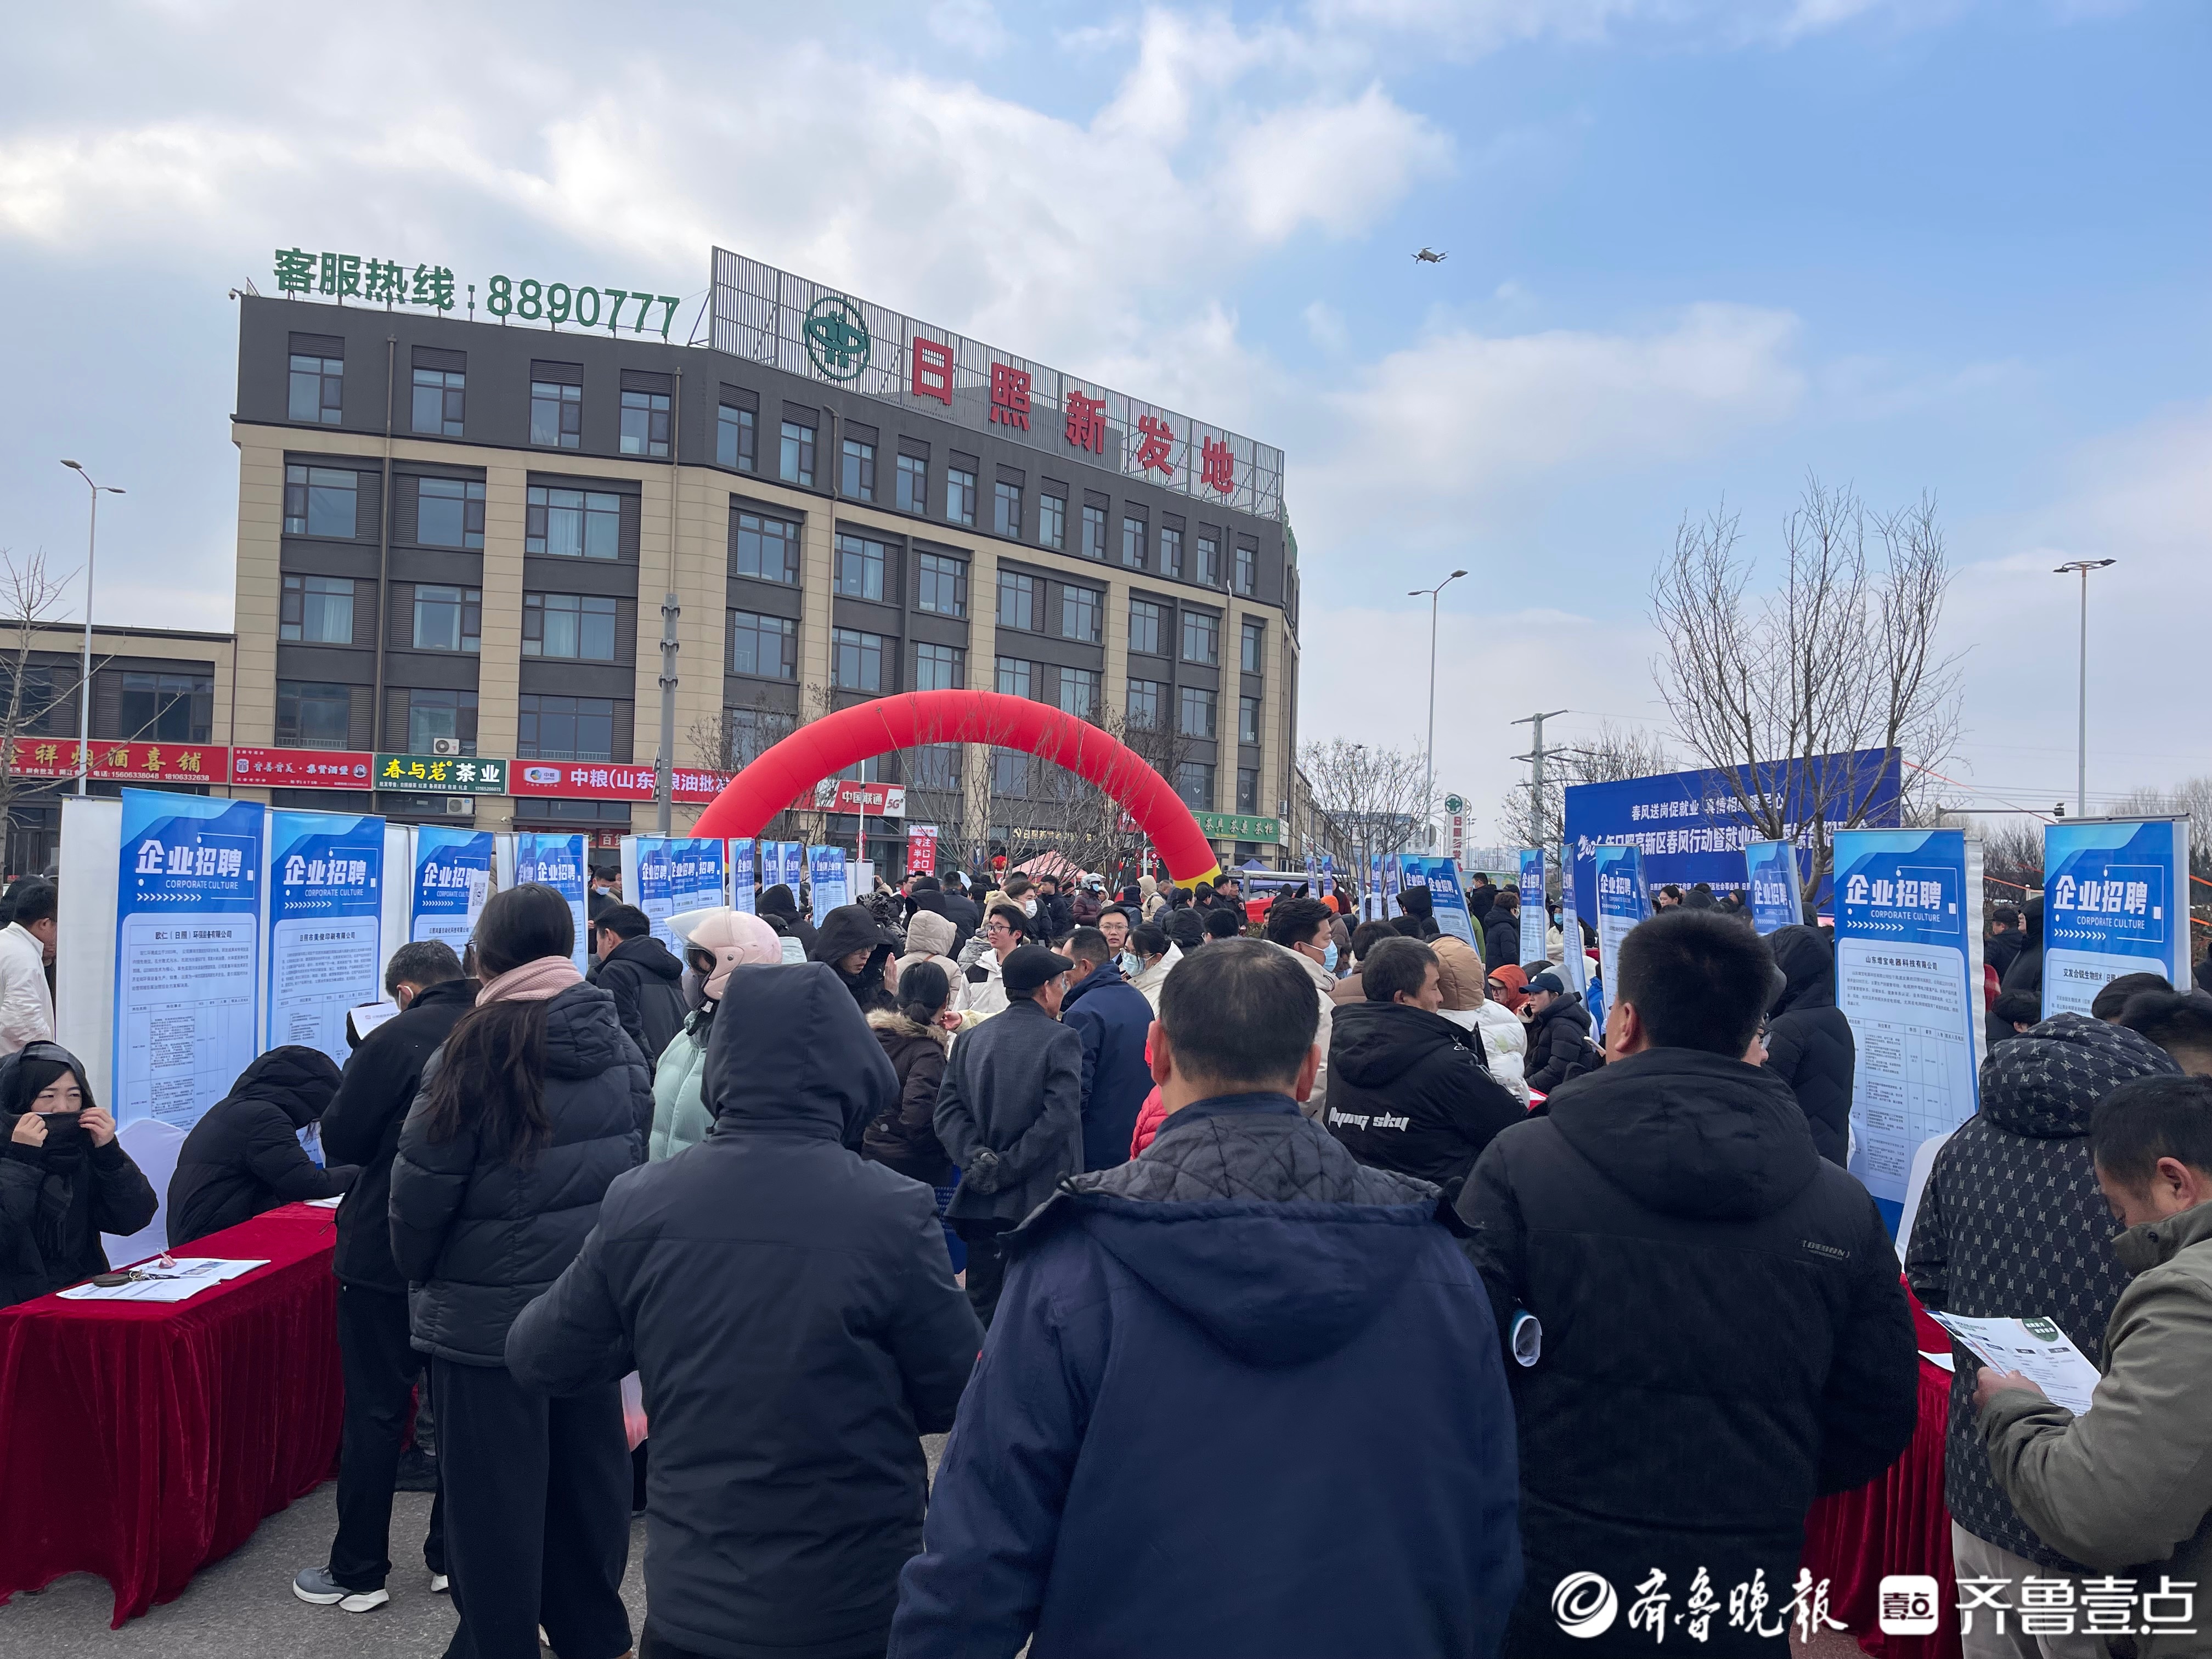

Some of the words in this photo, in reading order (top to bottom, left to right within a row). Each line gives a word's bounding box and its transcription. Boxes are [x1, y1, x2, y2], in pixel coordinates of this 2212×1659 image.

[912, 336, 1234, 493] 日照新发地
[1632, 799, 1699, 821] 春风送岗促就业
[135, 839, 242, 878] 企业招聘
[913, 849, 930, 857] 半口
[283, 855, 366, 885] 企业招聘
[537, 862, 575, 882] 企业招聘
[642, 862, 667, 881] 企业招聘
[912, 859, 929, 868] 全口
[166, 879, 207, 889] CORPORATE
[208, 881, 239, 890] CULTURE
[304, 889, 338, 897] CORPORATE
[340, 888, 363, 896] CULTURE
[1428, 877, 1454, 893] 企业招聘
[1600, 873, 1631, 896] 企业招聘
[1754, 880, 1788, 906] 企业招聘
[1845, 874, 1943, 910] 企业招聘
[2053, 875, 2148, 915] 企业招聘
[1871, 909, 1912, 921] CORPORATE
[1913, 911, 1940, 923] CULTURE
[2076, 916, 2112, 927] CORPORATE
[2113, 918, 2145, 929] CULTURE
